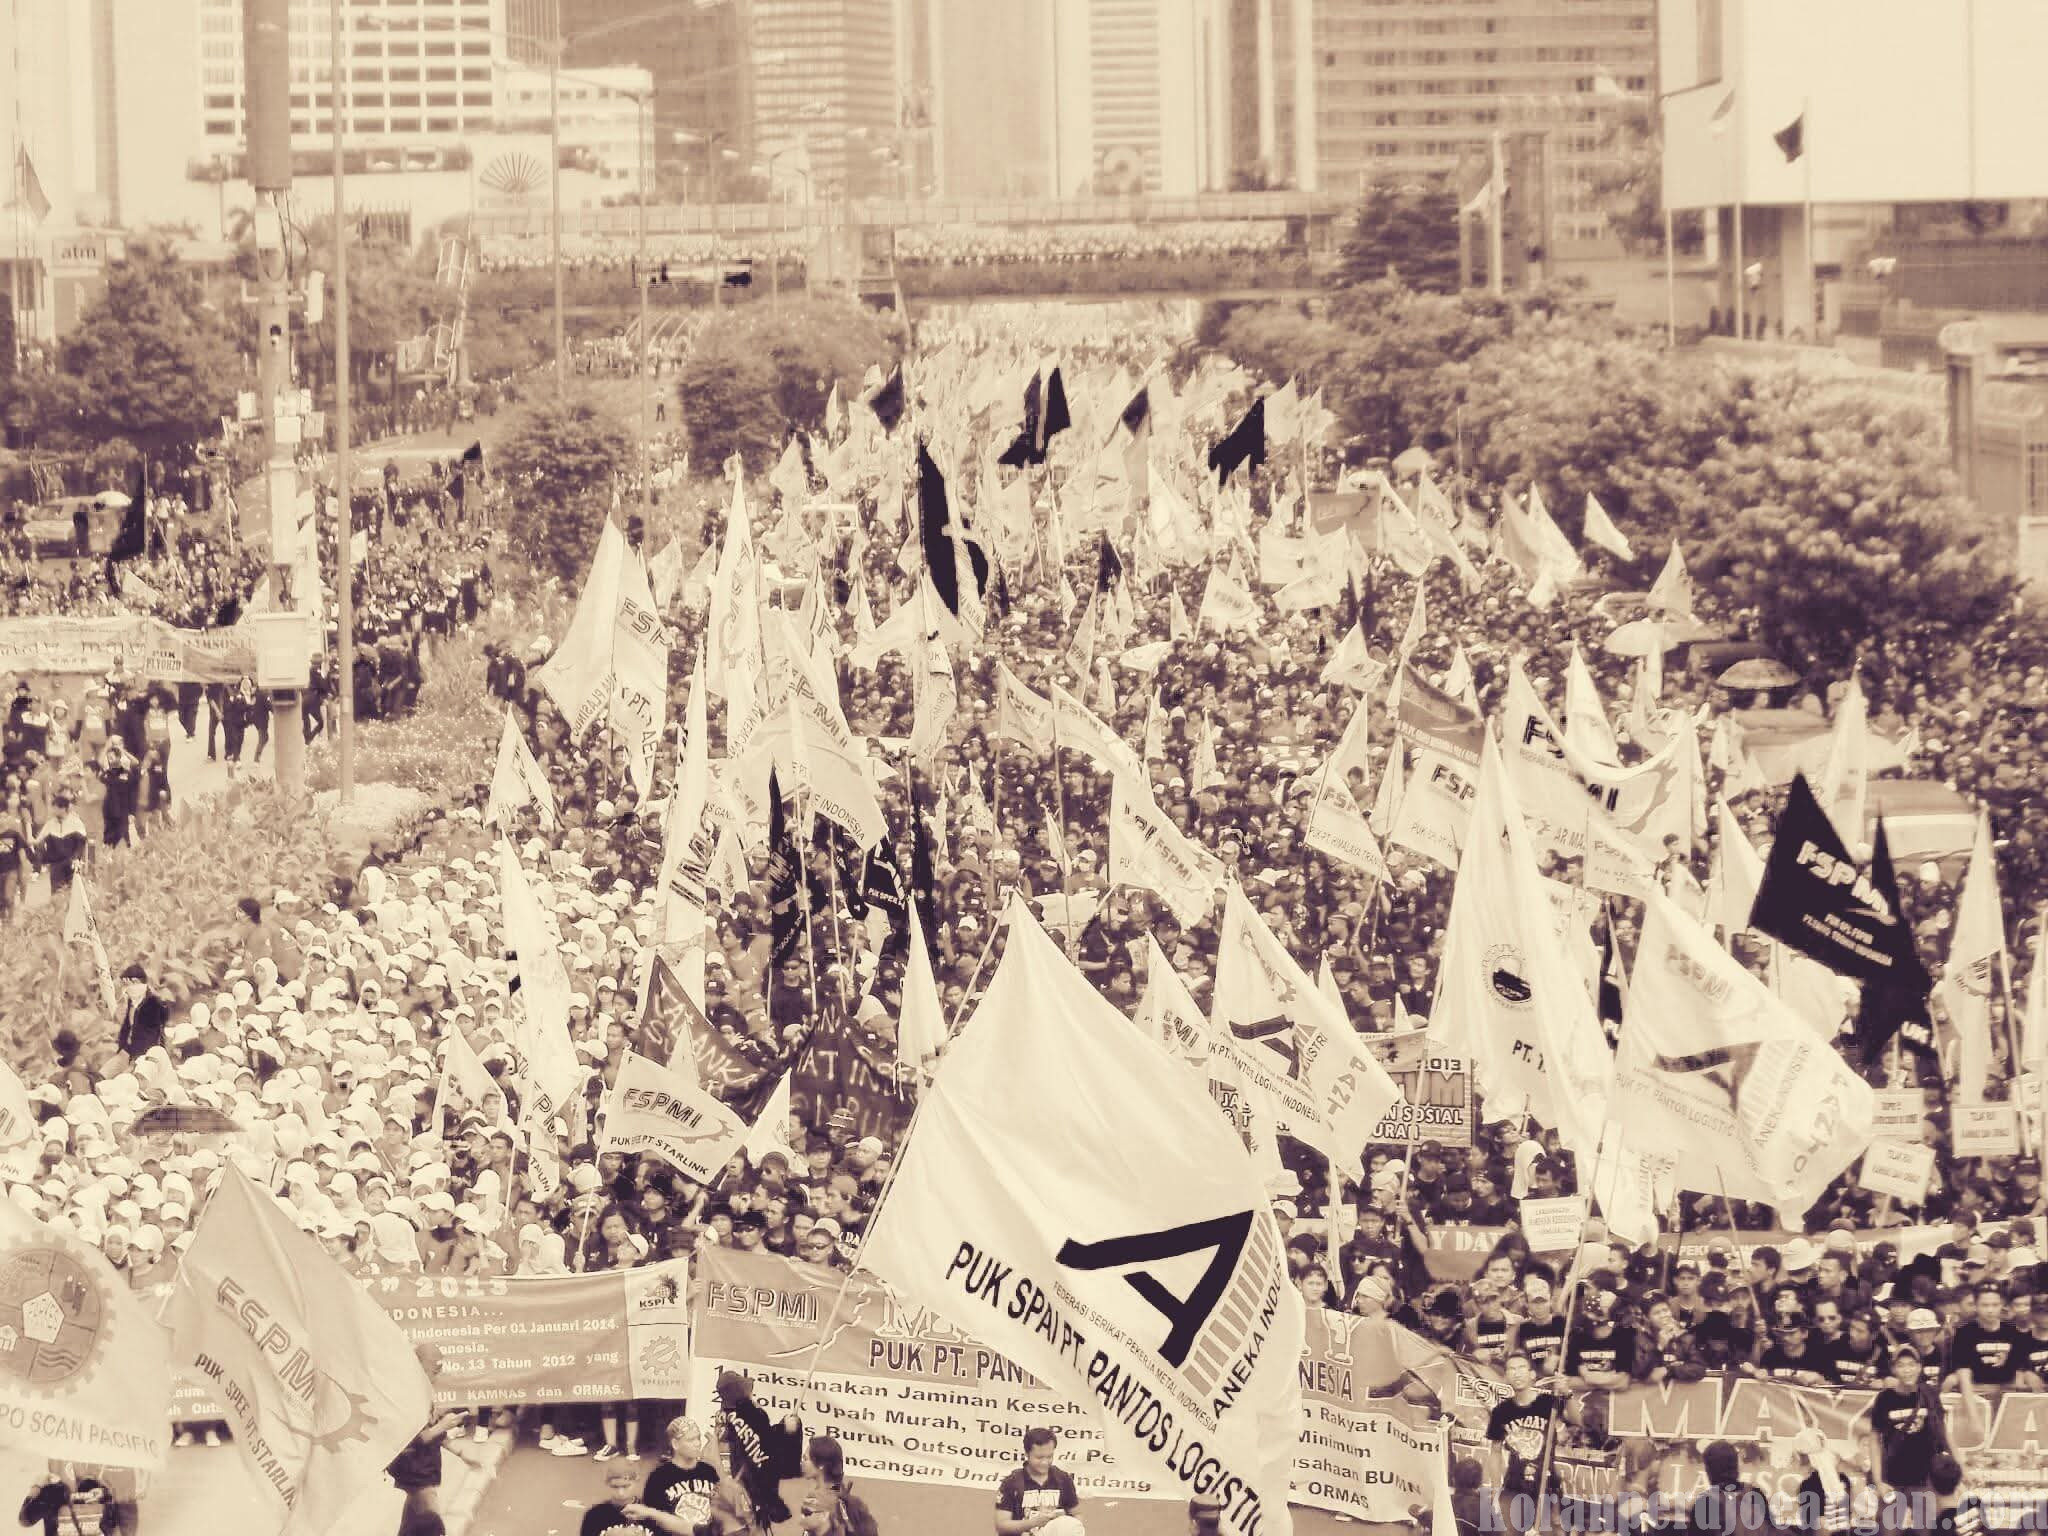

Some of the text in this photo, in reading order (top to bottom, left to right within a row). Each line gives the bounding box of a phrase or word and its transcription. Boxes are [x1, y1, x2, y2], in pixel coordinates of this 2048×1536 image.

[819, 801, 865, 841] INDONESIA
[1154, 838, 1193, 882] FSPMI
[1512, 1039, 1533, 1063] PT.
[623, 1088, 703, 1129] FSPMI
[1403, 1106, 1463, 1124] SOSIAL
[610, 1136, 630, 1146] PUK
[656, 1139, 709, 1175] STARLINK
[416, 1276, 510, 1298] 2013
[707, 1280, 819, 1323] FSPMI
[385, 1306, 505, 1321] DONESIA...
[639, 1298, 665, 1310] KSPI
[217, 1276, 316, 1401] FSPM
[412, 1325, 481, 1339] Indonesia
[484, 1322, 507, 1335] Per
[510, 1322, 528, 1334] 01
[530, 1318, 580, 1332] Januari
[583, 1317, 620, 1331] 2014.
[436, 1342, 489, 1355] onesia.
[868, 1338, 923, 1373] PUK
[932, 1345, 969, 1378] PT.
[946, 1241, 1012, 1309] PUK
[1007, 1277, 1060, 1348] SPAI
[1060, 1318, 1085, 1375] PT.
[1087, 1350, 1173, 1452] PANTOS
[1053, 1281, 1219, 1435] FEDERASI SERIKAT PEKERJA METAL INDONESIA
[441, 1351, 619, 1373] No. 13 Tahun 2012 yang
[1211, 1331, 1266, 1420] ANEKA
[434, 1384, 625, 1402] UU KAMNAS dan ORMAS.
[897, 1386, 999, 1410] Jaminan
[1006, 1398, 1088, 1416] Keseh
[1456, 1373, 1515, 1408] FSP
[751, 1396, 807, 1412] olak
[816, 1400, 876, 1422] Upah
[885, 1409, 967, 1434] Murah,
[1320, 1406, 1378, 1433] Rakyat
[1937, 1392, 2048, 1454] DA
[30, 1411, 83, 1442] SCAN
[88, 1424, 160, 1459] PACIFIC
[194, 1353, 225, 1385] PUK
[225, 1379, 250, 1417] SPEE
[251, 1435, 297, 1512] STARLIN
[826, 1425, 895, 1447] Buruh
[844, 1456, 945, 1477] ncangan
[665, 1480, 692, 1502] MAY
[1308, 1482, 1370, 1509] ORMAS
[1365, 1471, 1423, 1496] BUMN
